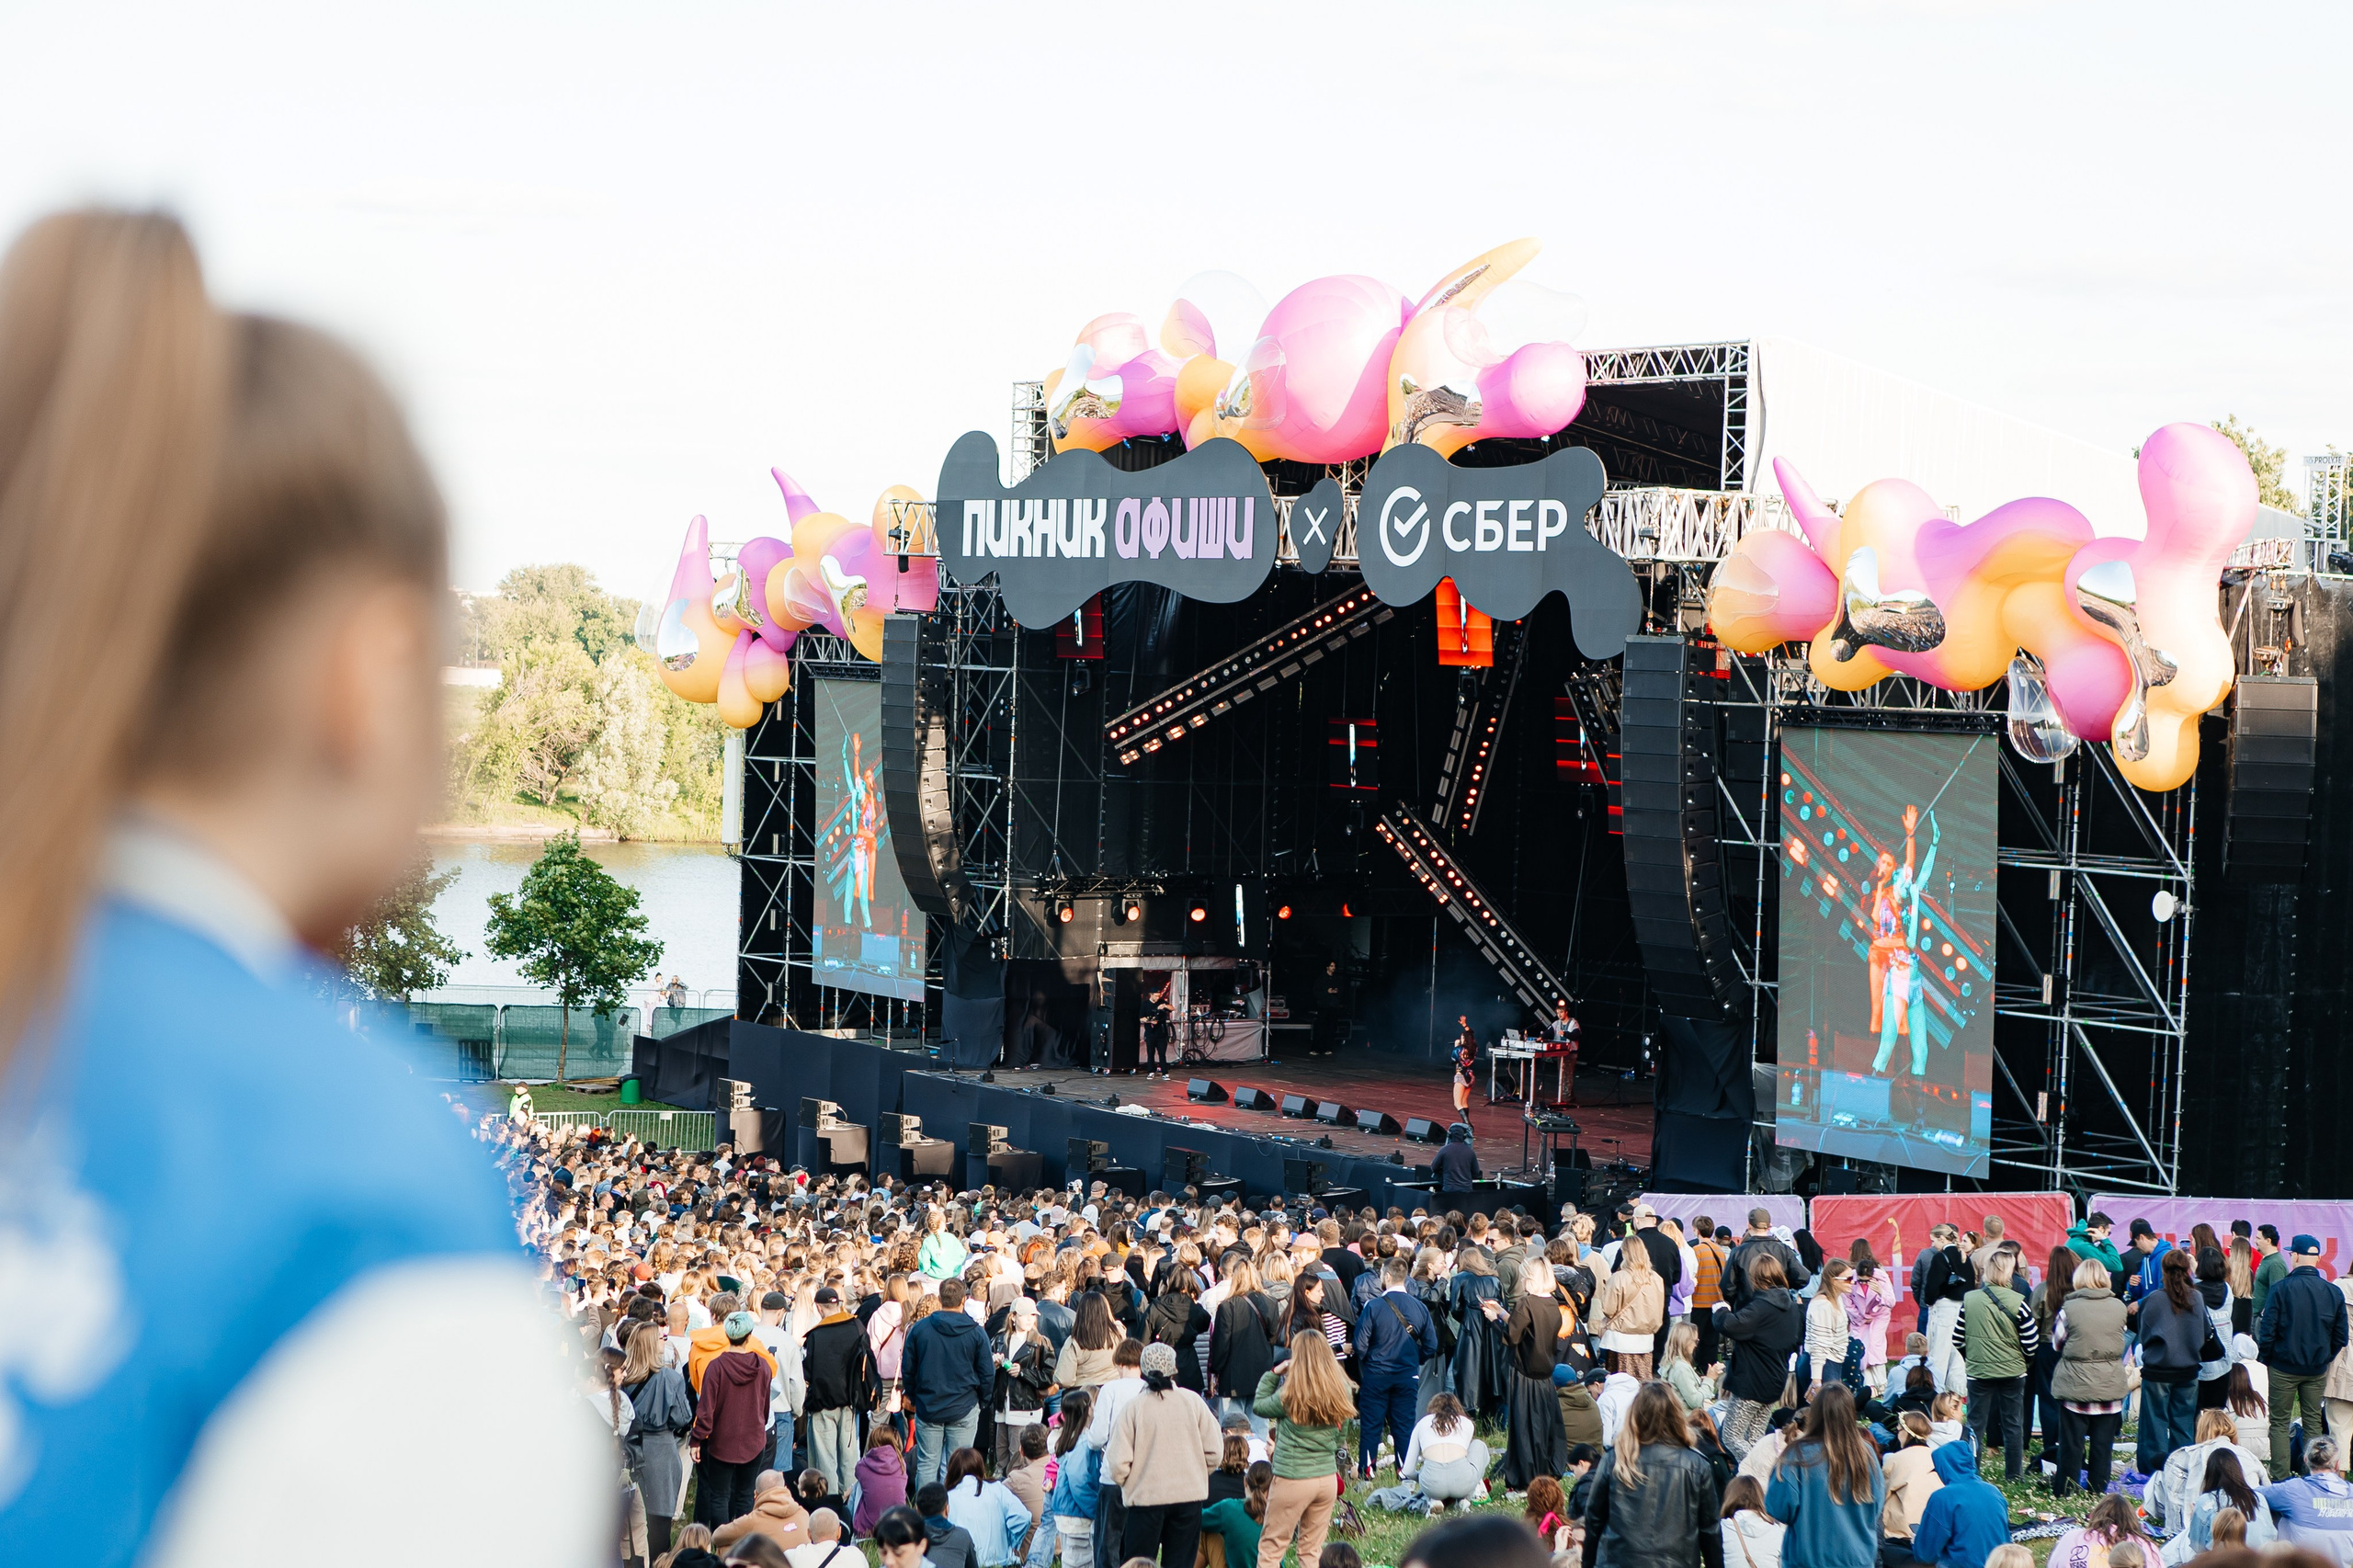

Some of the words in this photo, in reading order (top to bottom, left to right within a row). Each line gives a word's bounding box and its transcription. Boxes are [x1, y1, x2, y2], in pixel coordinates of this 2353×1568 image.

[2313, 456, 2342, 464] PROLYTE
[961, 498, 1108, 558] ПИКНИК
[1441, 499, 1568, 552] СБЕР
[2069, 1544, 2089, 1562] 20
